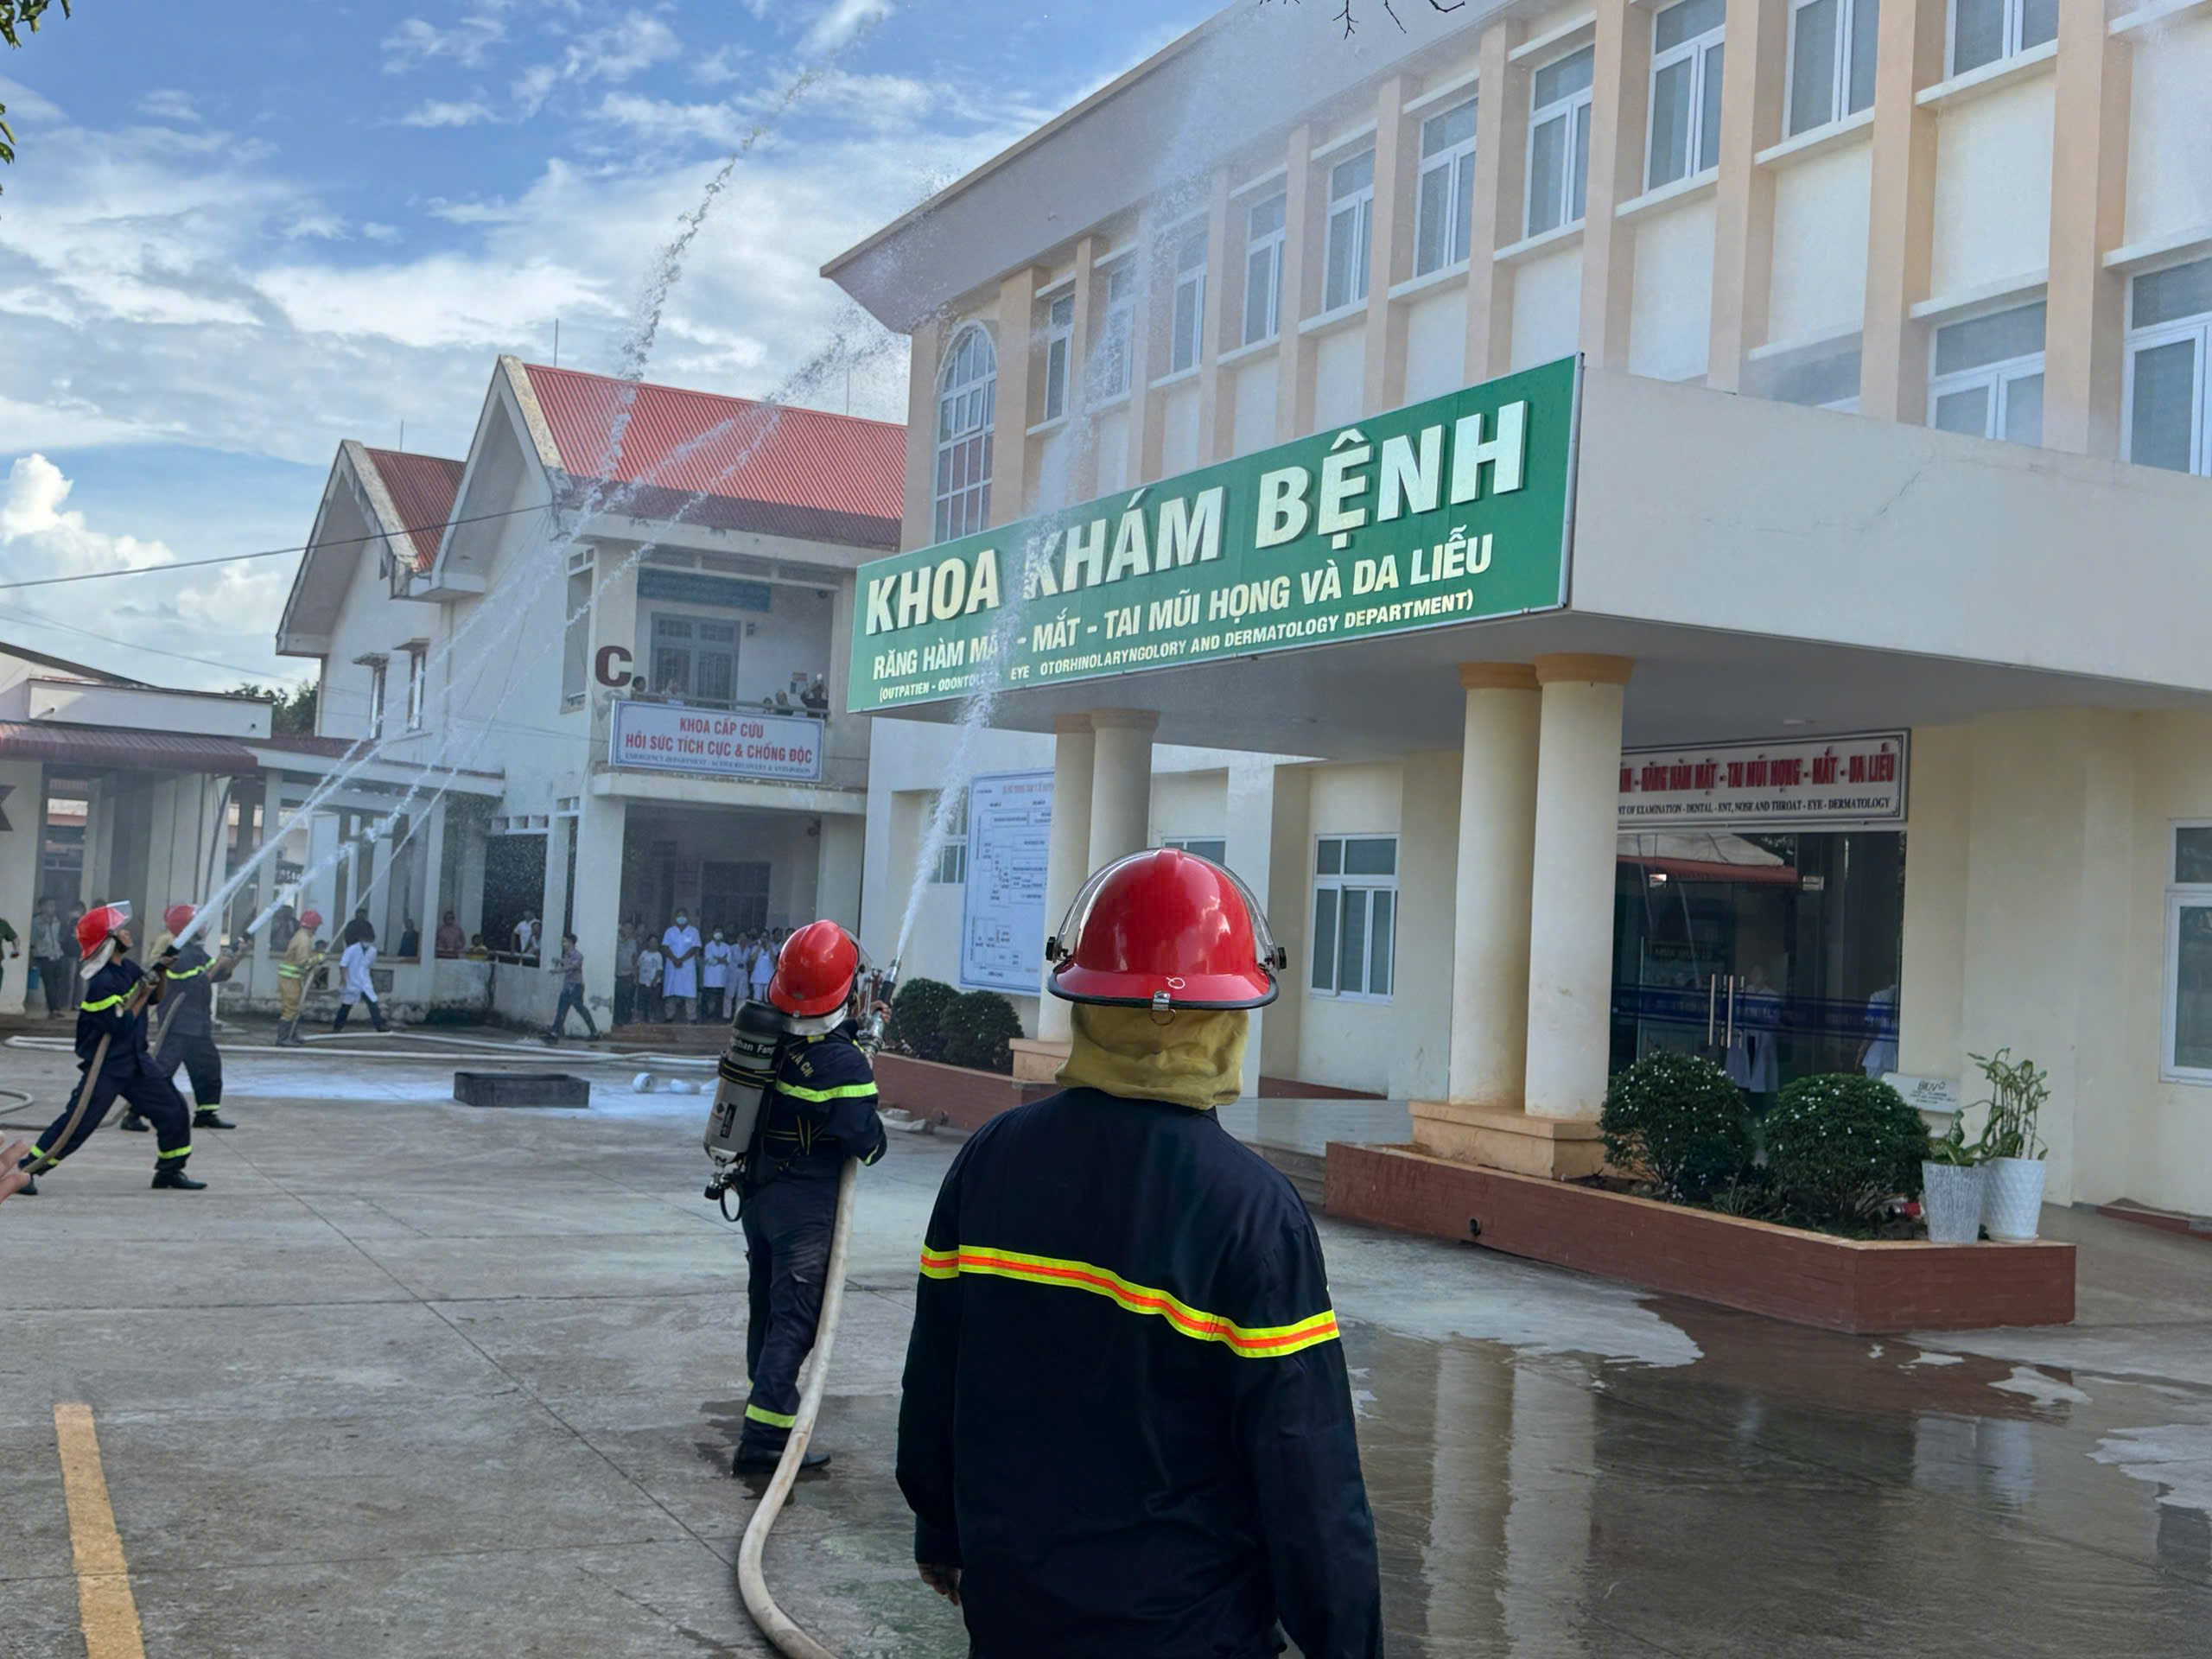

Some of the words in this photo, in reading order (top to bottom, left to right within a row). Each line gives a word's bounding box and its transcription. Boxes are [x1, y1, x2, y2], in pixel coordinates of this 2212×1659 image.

[866, 549, 1001, 636] KHOA
[1023, 486, 1225, 600] KHÁM
[1255, 400, 1529, 550] BỆNH
[873, 648, 918, 681] RĂNG
[922, 638, 965, 672] HÀM
[1033, 607, 1081, 652] MẮT
[1104, 605, 1141, 639] TAI
[1148, 588, 1200, 632] MŨI
[1209, 575, 1291, 625] HỌNG
[1300, 559, 1342, 605] VÀ
[1352, 555, 1399, 596] DA
[1410, 524, 1493, 586] LIỄU
[1010, 665, 1030, 681] EYE
[1040, 640, 1187, 676] OTORHINOLARYNGOLORY
[1191, 636, 1220, 653] AND
[1224, 615, 1338, 648] DERMATOLOGY
[1344, 588, 1473, 629] DEPARTMENT)
[595, 645, 632, 688] C
[626, 729, 646, 749] HỒI
[650, 734, 672, 752] SỨC
[677, 735, 704, 754] TÍCH
[708, 740, 731, 759] CỰC
[734, 744, 743, 758] &
[747, 741, 786, 761] CHỐNG
[789, 746, 812, 766] ĐỘC
[679, 717, 710, 734] KHOA
[715, 717, 736, 737] CẤP
[1772, 800, 1802, 811] THROAT
[1828, 797, 1891, 810] DERMATOLOGY
